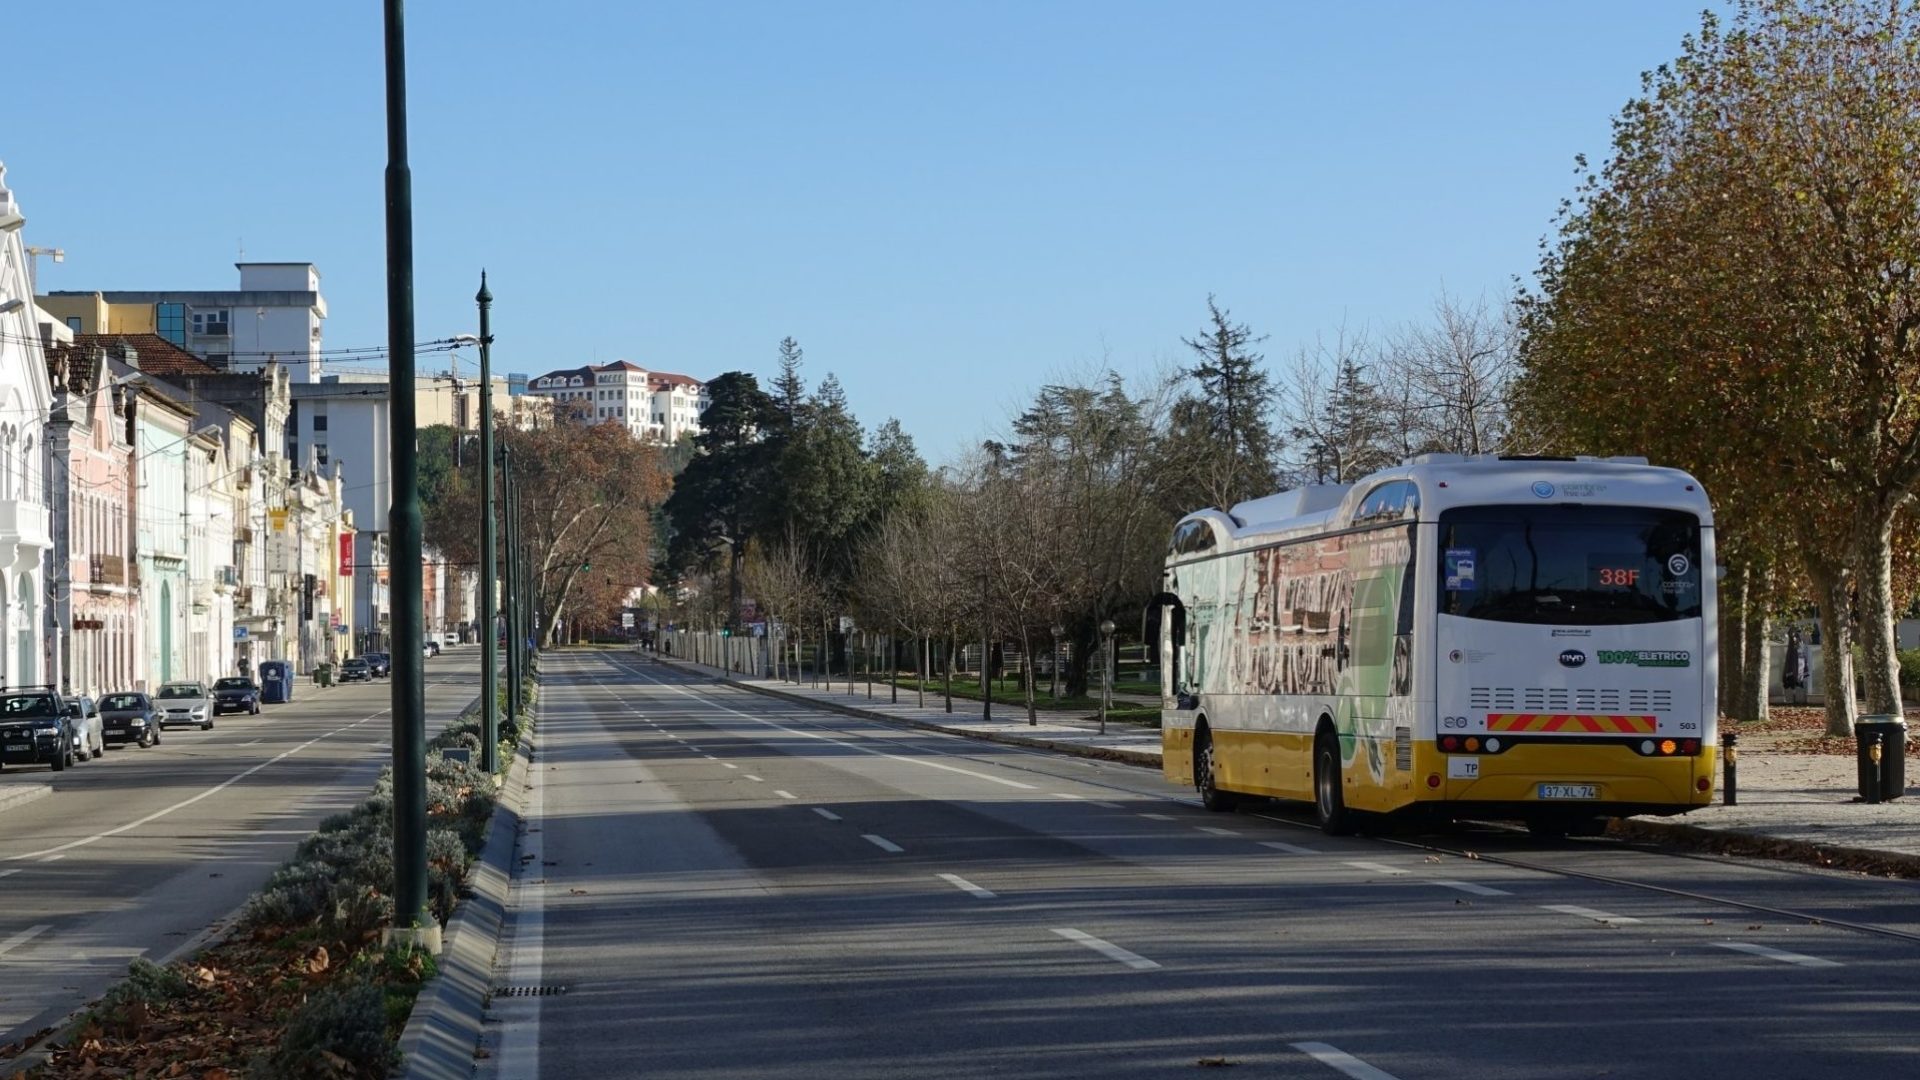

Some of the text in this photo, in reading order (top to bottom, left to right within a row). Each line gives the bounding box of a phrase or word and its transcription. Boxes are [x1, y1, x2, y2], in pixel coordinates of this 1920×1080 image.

[1599, 568, 1640, 585] 38F
[1597, 650, 1638, 664] 100%
[1679, 722, 1696, 730] 503
[1465, 763, 1478, 774] TP
